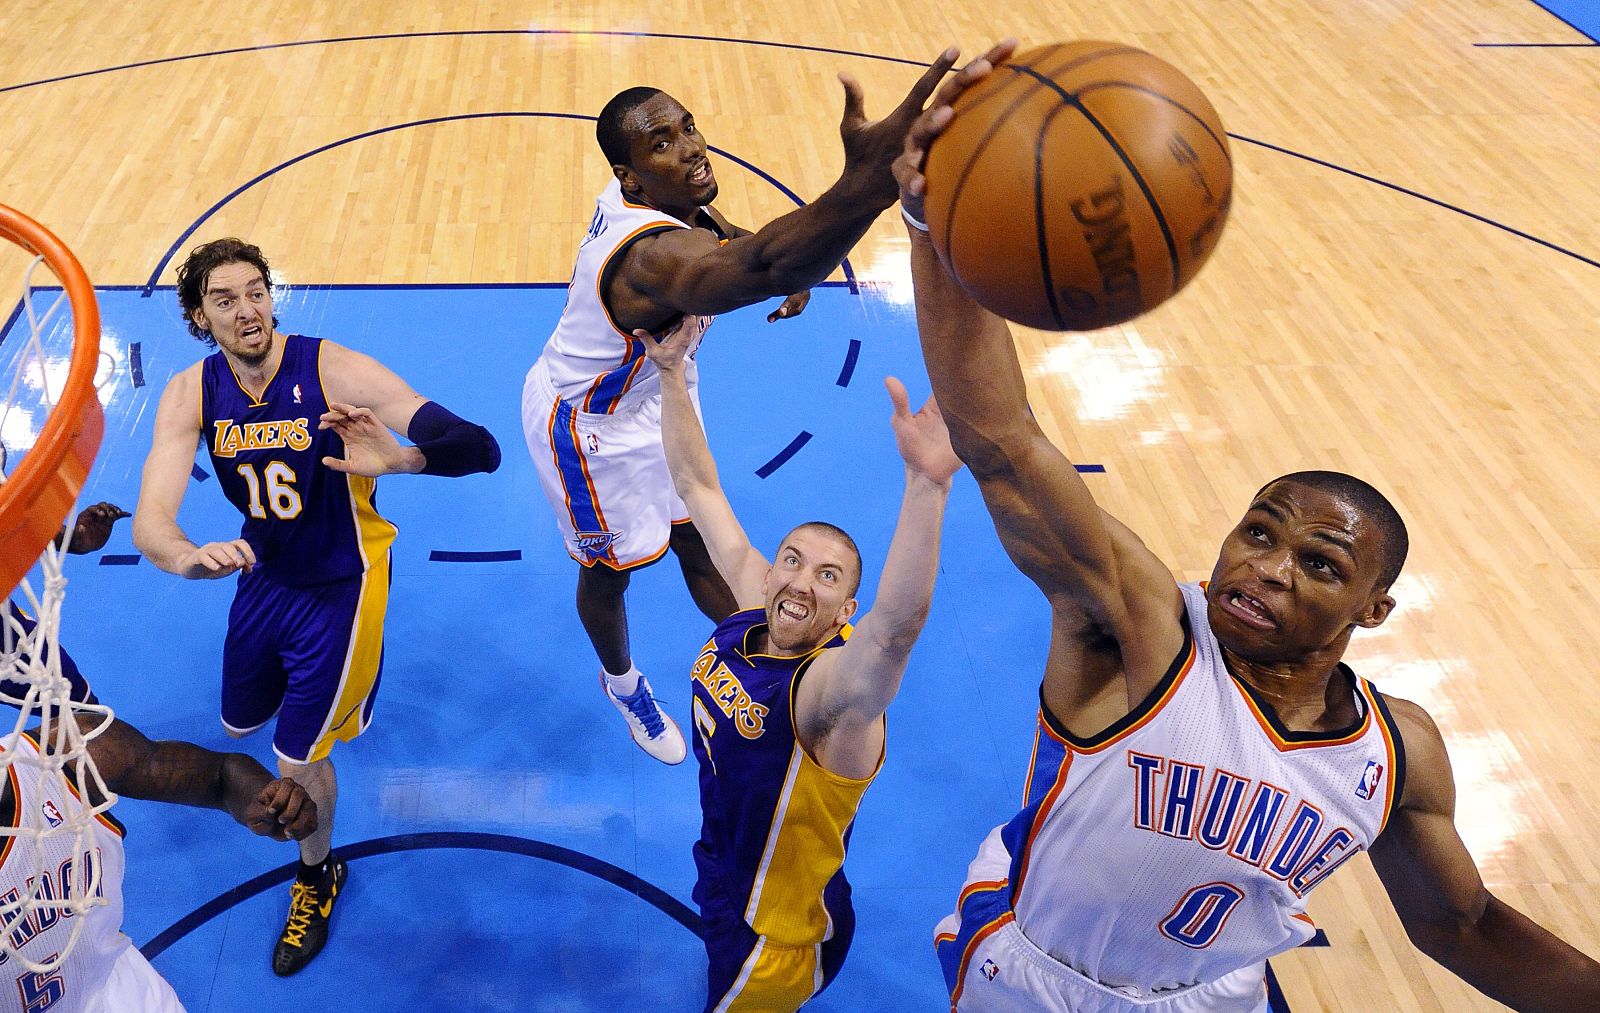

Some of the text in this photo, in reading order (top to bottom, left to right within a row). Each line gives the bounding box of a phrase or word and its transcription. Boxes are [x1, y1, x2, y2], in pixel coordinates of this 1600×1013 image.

[213, 417, 312, 458] LAKERS
[237, 460, 303, 520] 16
[1127, 749, 1363, 899] THUNDE
[1157, 881, 1246, 949] 0
[16, 952, 66, 1013] 5
